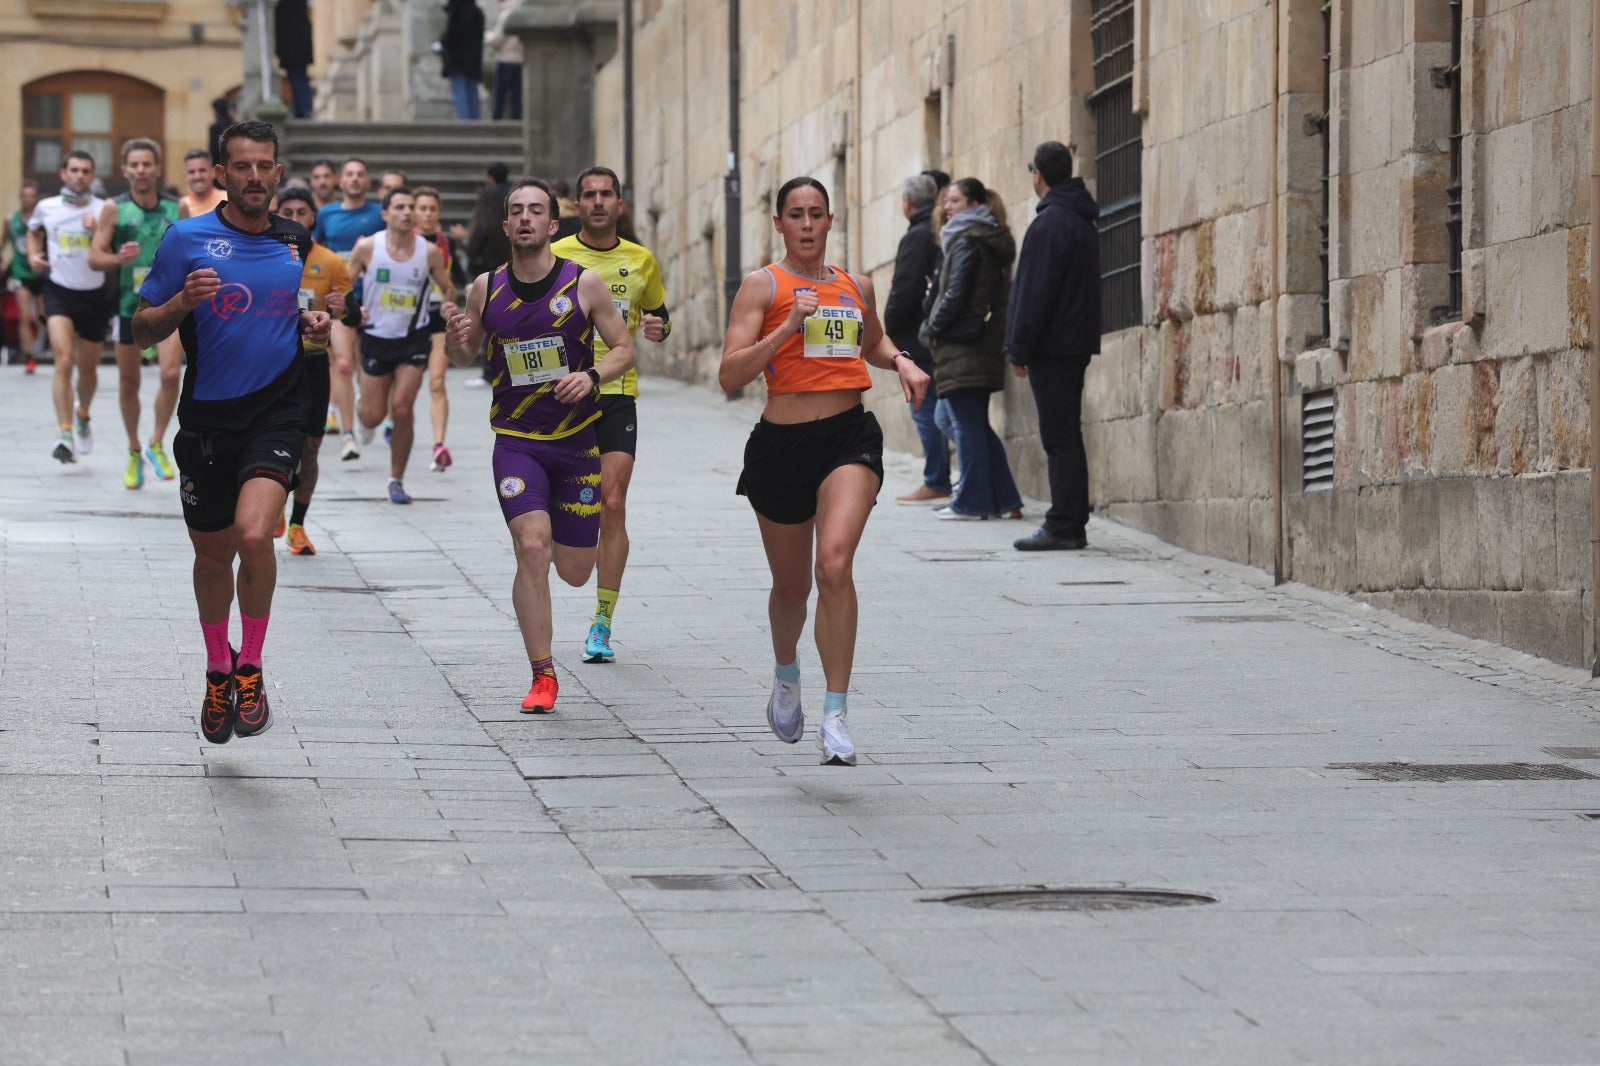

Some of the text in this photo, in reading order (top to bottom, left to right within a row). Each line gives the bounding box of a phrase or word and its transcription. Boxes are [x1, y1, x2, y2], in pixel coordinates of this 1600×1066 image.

[609, 285, 626, 293] GO
[822, 309, 857, 319] SETEL
[824, 320, 844, 339] 49
[519, 340, 557, 351] SETEL
[522, 351, 543, 369] 181
